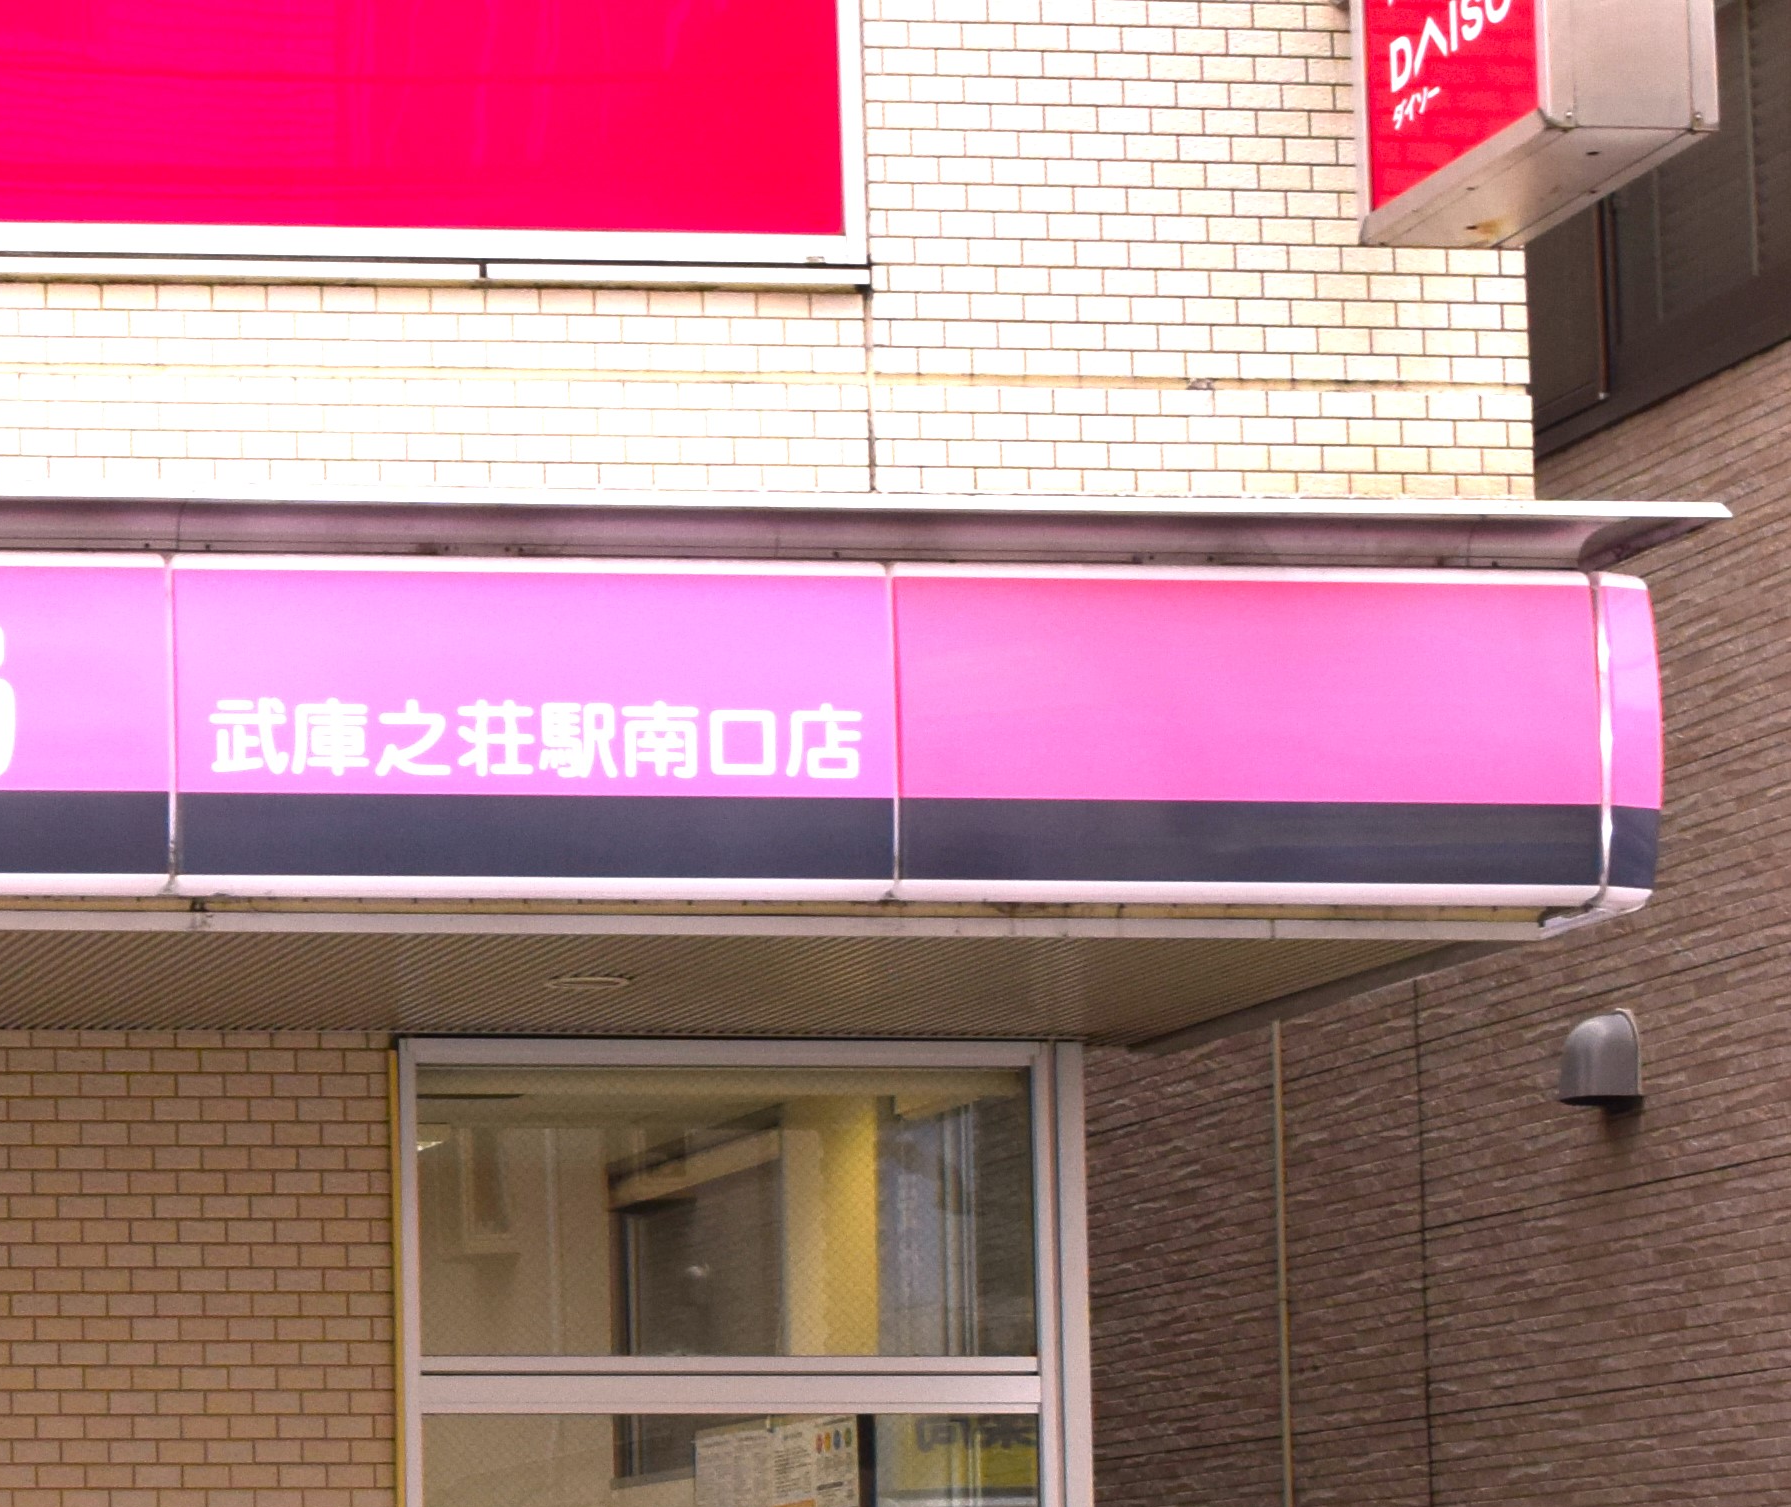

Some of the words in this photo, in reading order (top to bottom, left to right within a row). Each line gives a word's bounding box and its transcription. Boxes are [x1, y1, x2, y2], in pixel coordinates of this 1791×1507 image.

[1392, 86, 1441, 131] ダイソー
[209, 697, 863, 780] 武庫之荘駅南口店
